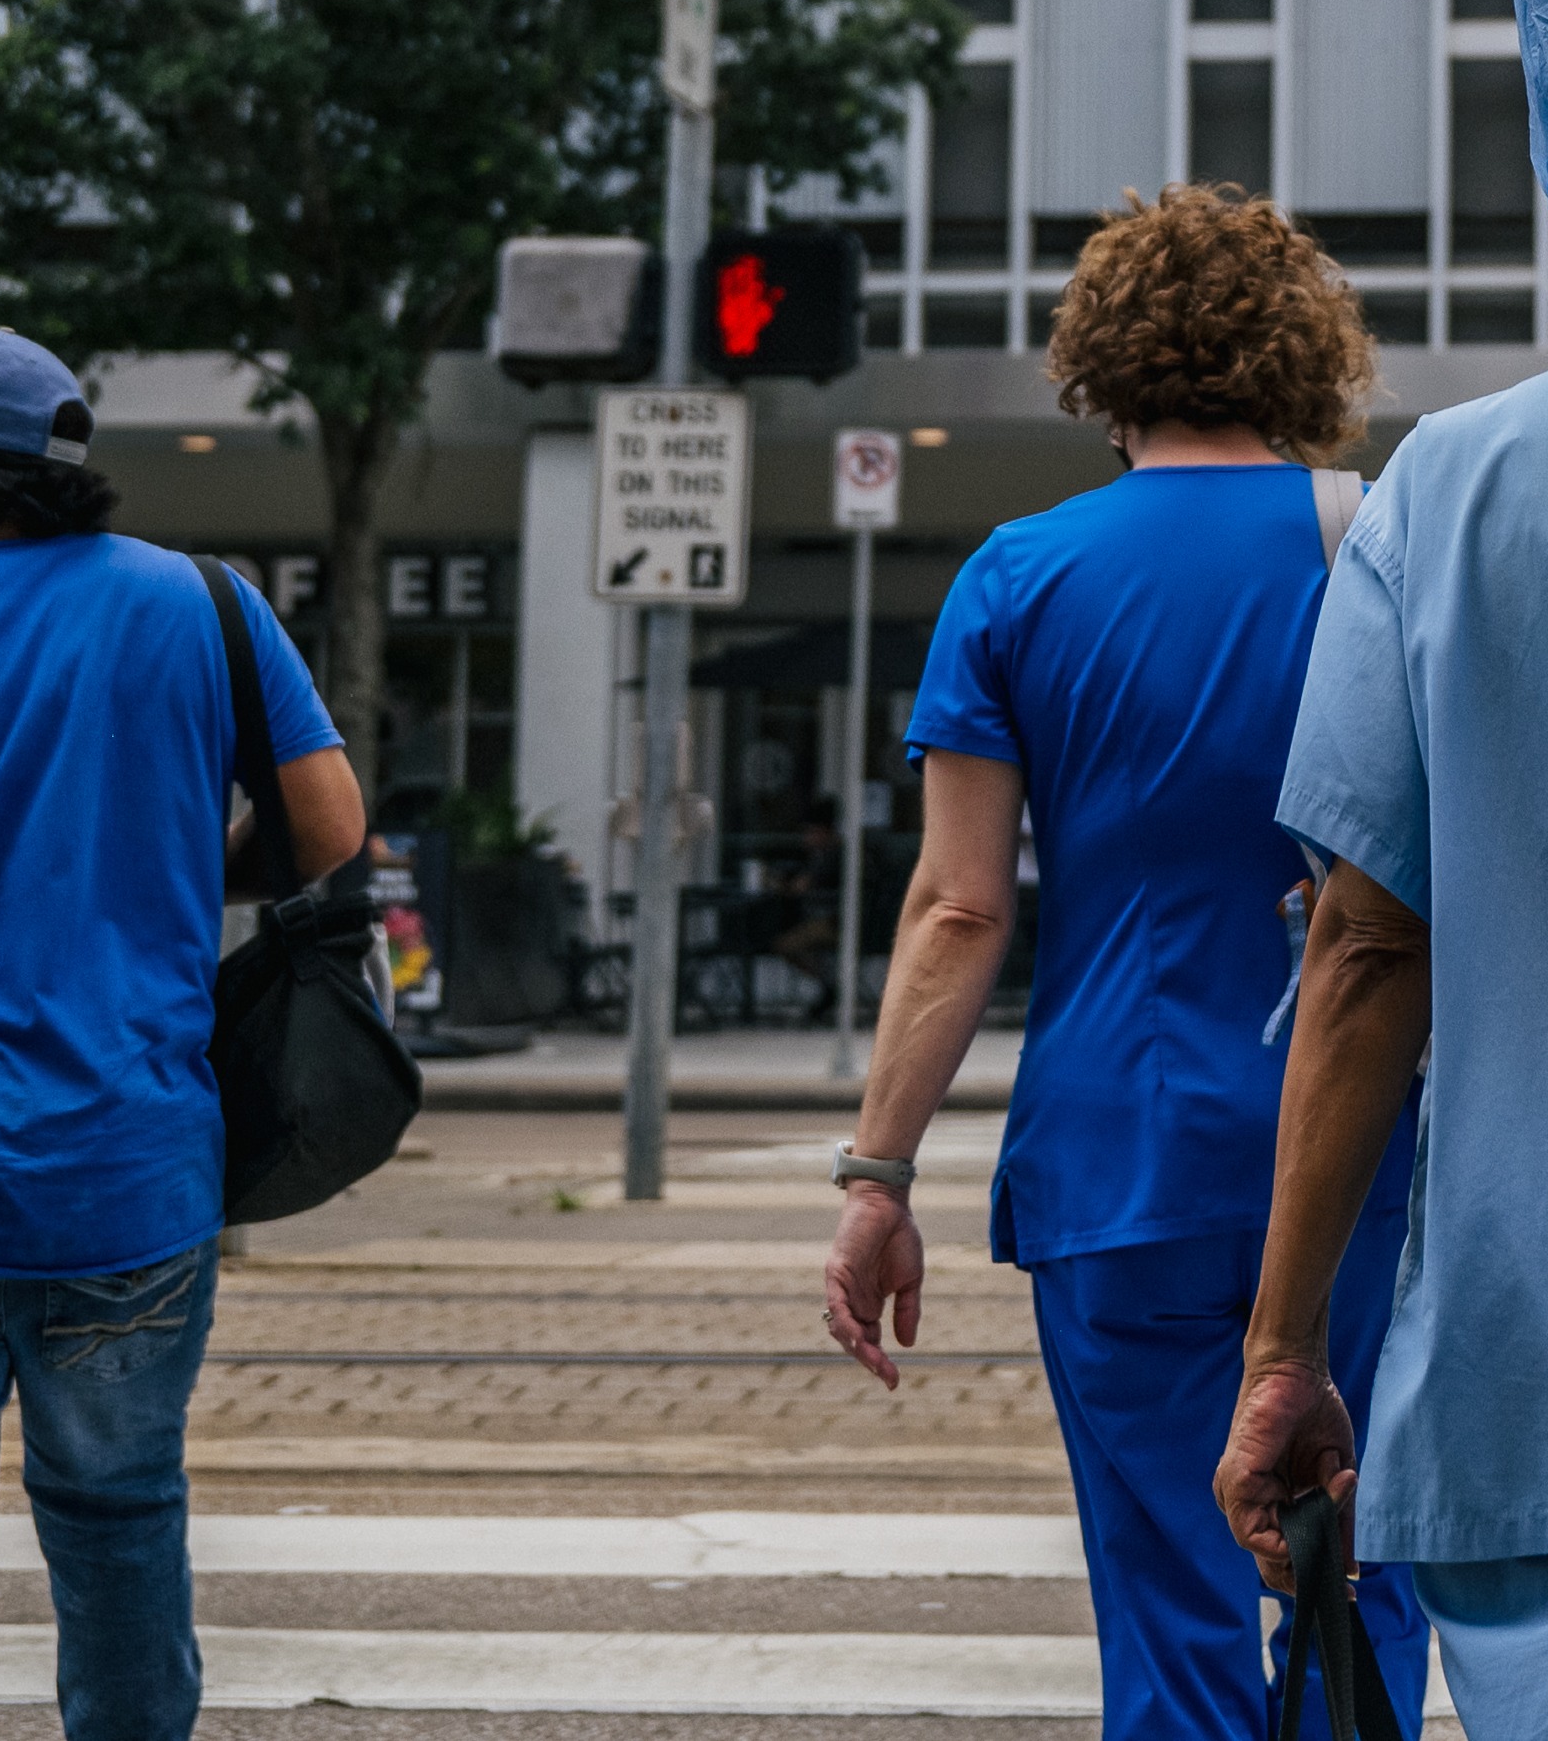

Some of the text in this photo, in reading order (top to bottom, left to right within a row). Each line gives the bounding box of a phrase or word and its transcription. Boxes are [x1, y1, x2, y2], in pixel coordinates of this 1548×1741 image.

[618, 432, 727, 458] TO HERE
[617, 469, 725, 496] ON THIS
[625, 506, 715, 533] SIGNAL
